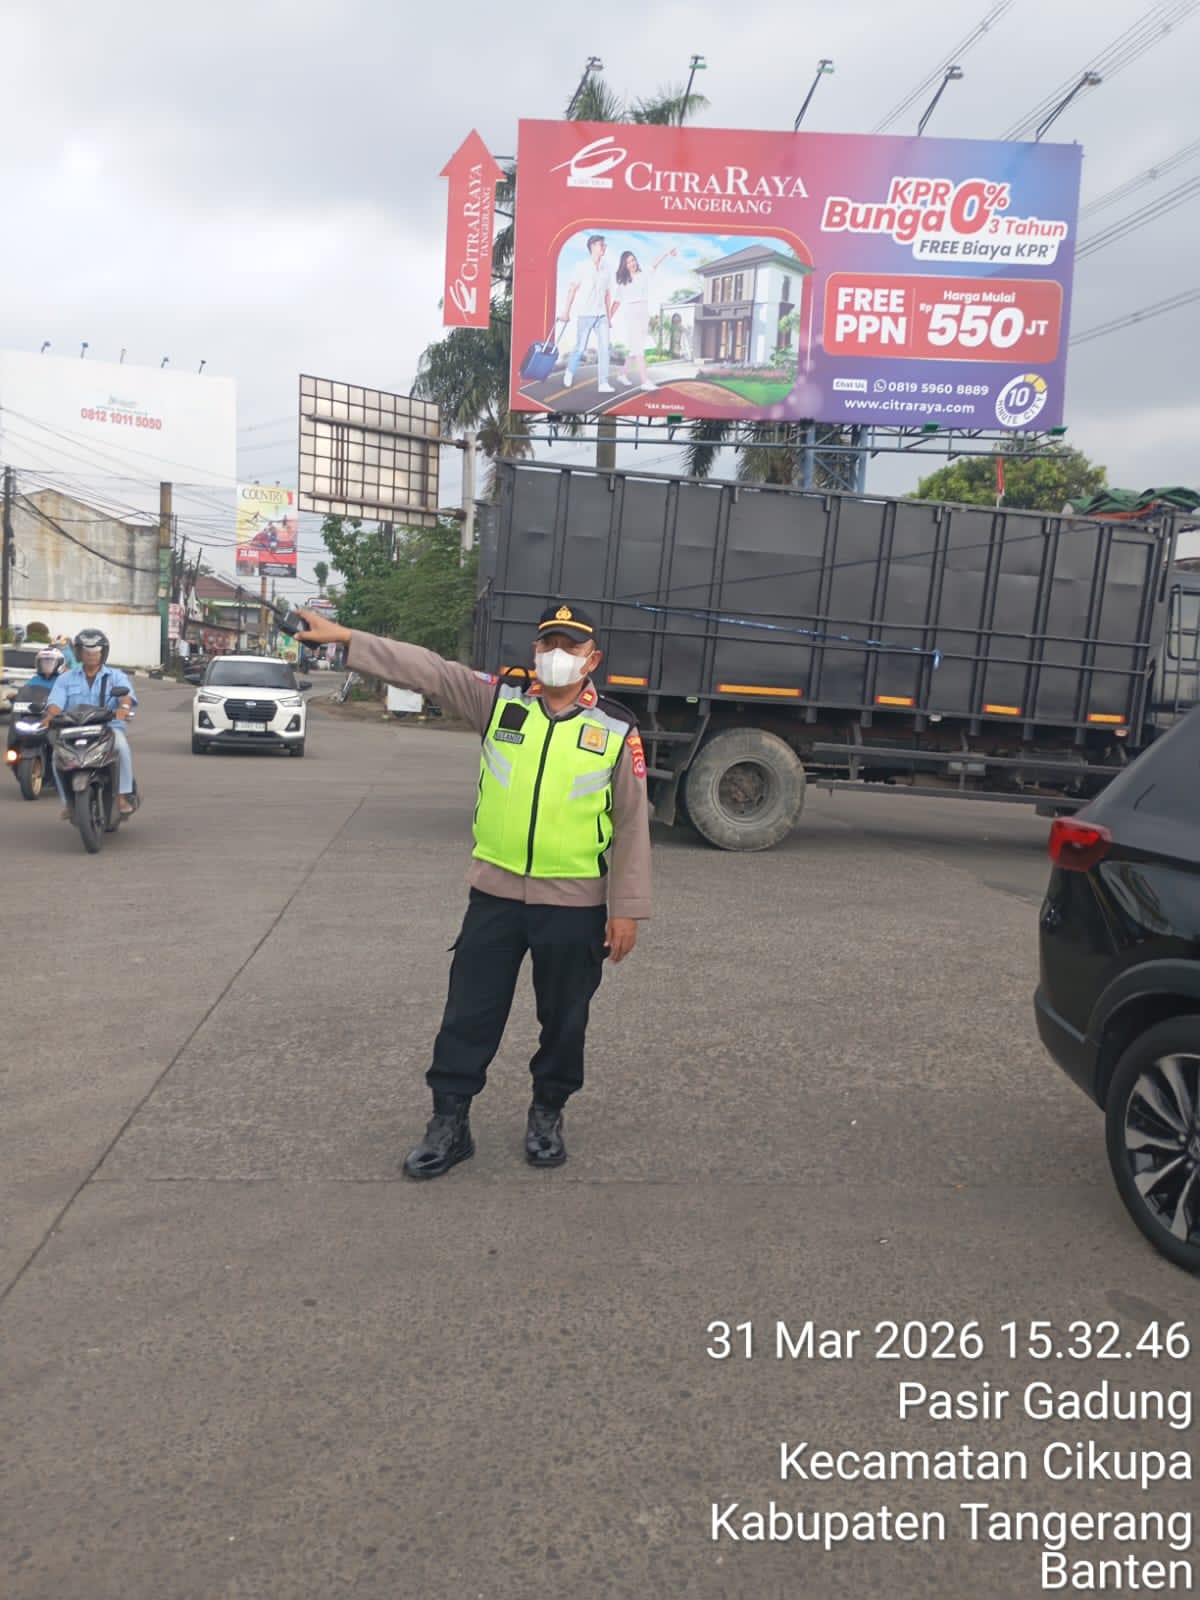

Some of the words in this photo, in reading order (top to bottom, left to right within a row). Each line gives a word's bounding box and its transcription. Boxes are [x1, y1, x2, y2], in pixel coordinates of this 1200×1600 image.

[890, 179, 951, 207] KPR
[661, 195, 773, 215] TANGERANG
[824, 200, 946, 241] Bunga
[988, 220, 999, 236] 3
[1005, 219, 1066, 237] Tahun
[919, 239, 959, 255] FREE
[962, 241, 1011, 260] Biaya
[837, 286, 905, 313] FREE
[944, 290, 980, 304] Harga
[982, 291, 1016, 304] Mulai
[835, 313, 907, 345] PPN
[927, 303, 1025, 349] 550
[1025, 320, 1049, 336] JT
[888, 381, 918, 393] 0819
[922, 382, 953, 394] 5960
[957, 383, 990, 396] 8889
[1008, 387, 1030, 408] 10
[81, 407, 107, 422] 0812
[110, 412, 134, 426] 1011
[844, 399, 976, 414] www.citraraya.com
